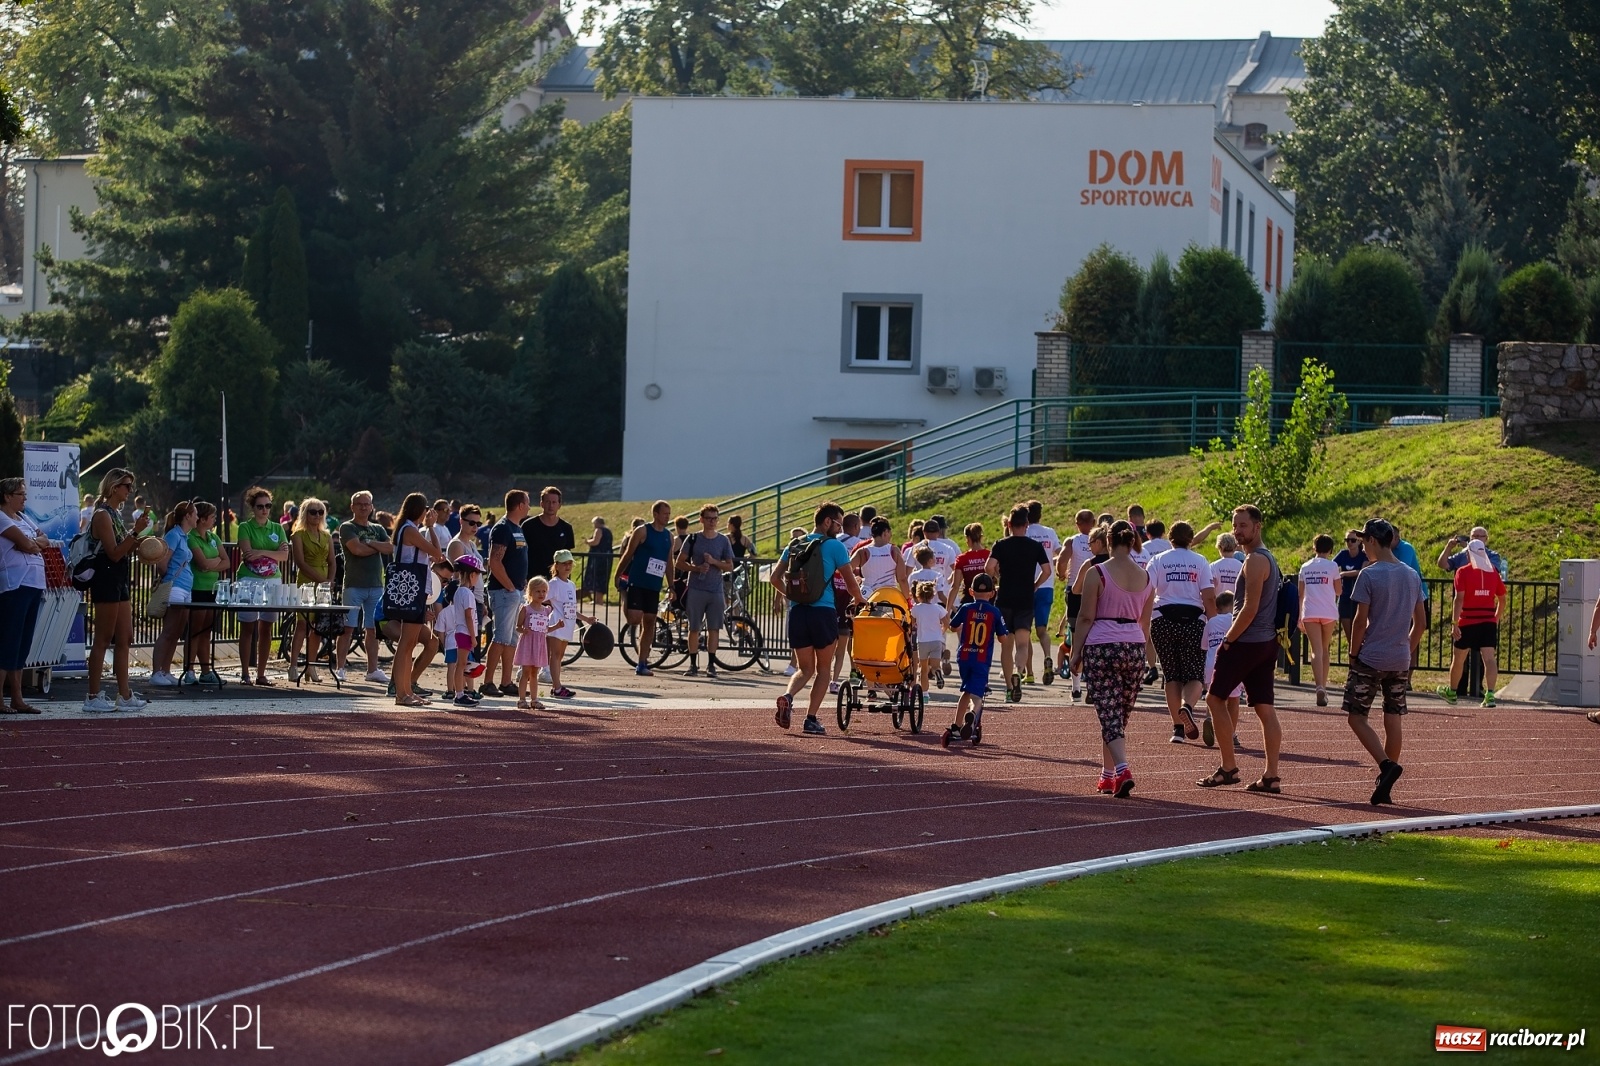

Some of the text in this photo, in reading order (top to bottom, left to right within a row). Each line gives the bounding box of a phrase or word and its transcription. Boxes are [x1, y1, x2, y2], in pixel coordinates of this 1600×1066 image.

[1088, 149, 1184, 186] DOM
[1080, 189, 1194, 207] SPORTOWCA
[41, 461, 59, 473] Jakość
[29, 478, 57, 490] każdego dnia
[972, 611, 988, 620] MESSI
[968, 620, 987, 647] 10
